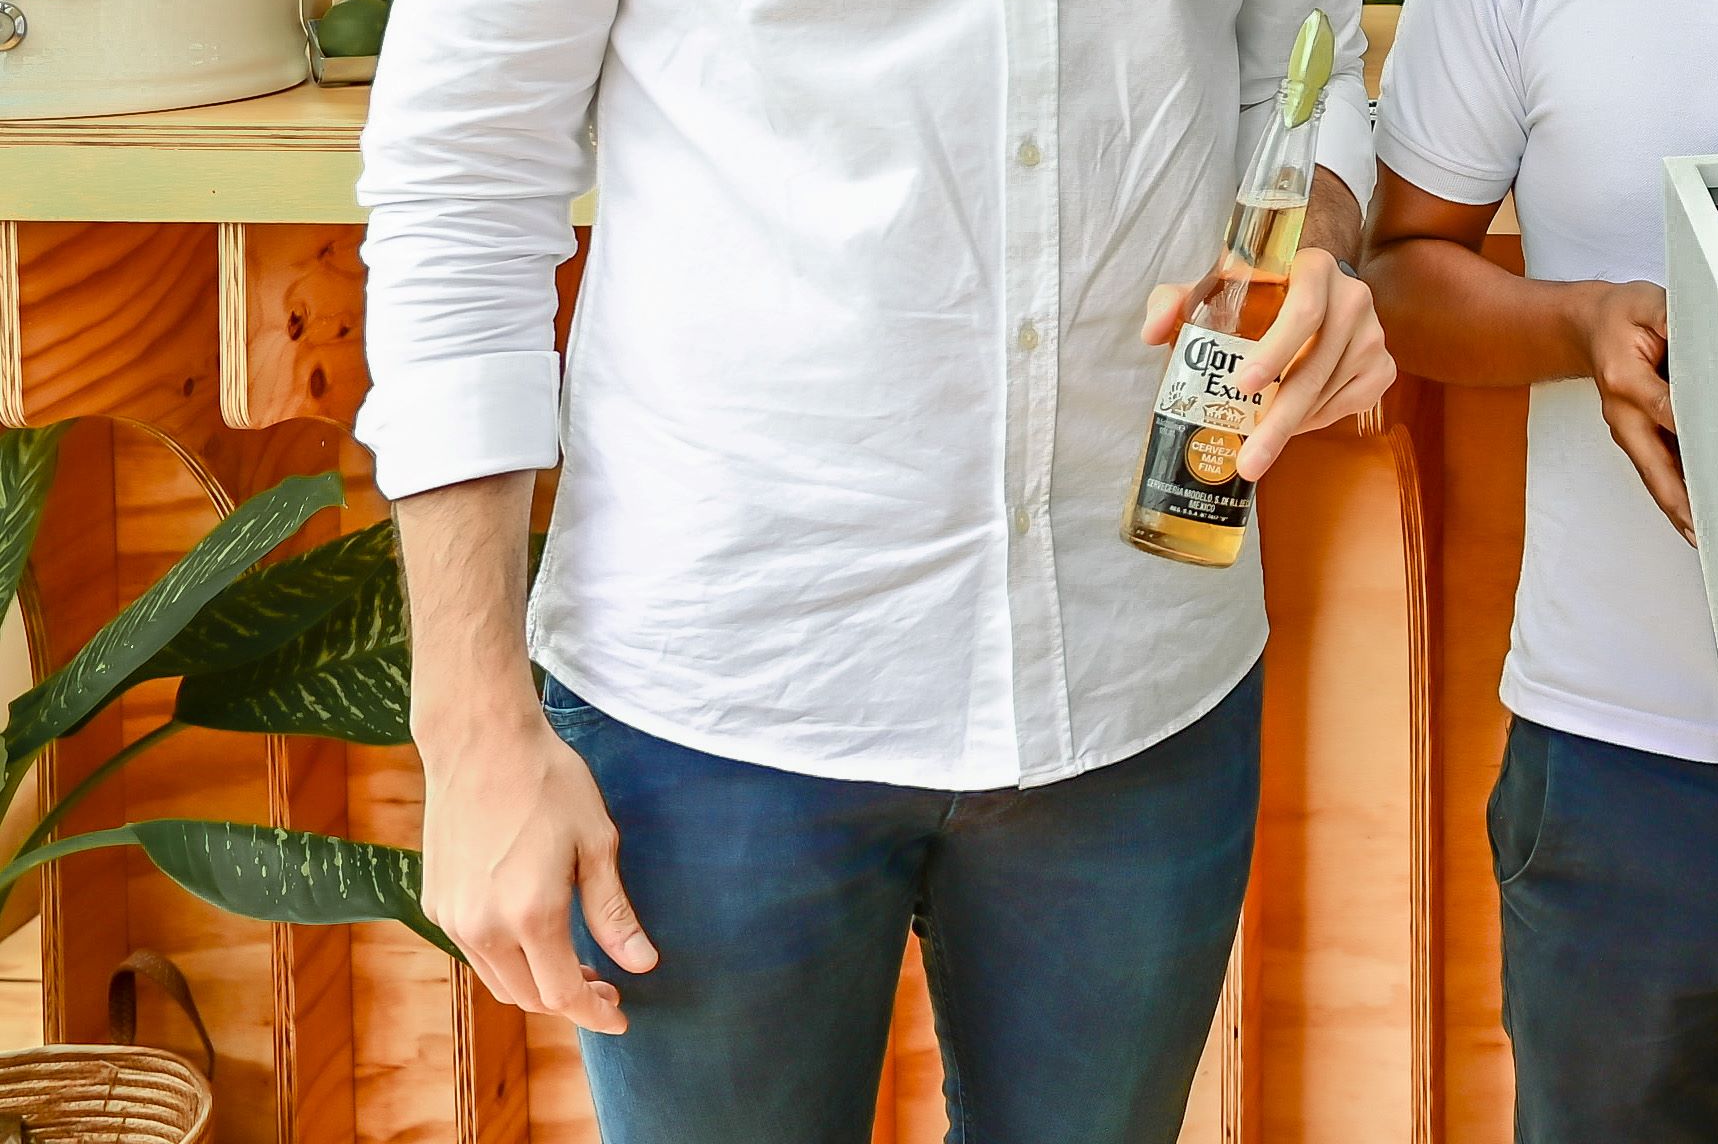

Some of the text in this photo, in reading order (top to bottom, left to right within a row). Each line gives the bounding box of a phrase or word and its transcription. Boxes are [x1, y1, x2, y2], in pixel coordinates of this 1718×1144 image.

[1204, 373, 1263, 405] Exta
[1210, 436, 1224, 446] LA
[1191, 441, 1237, 457] CERVEZA
[1198, 462, 1222, 474] FINA
